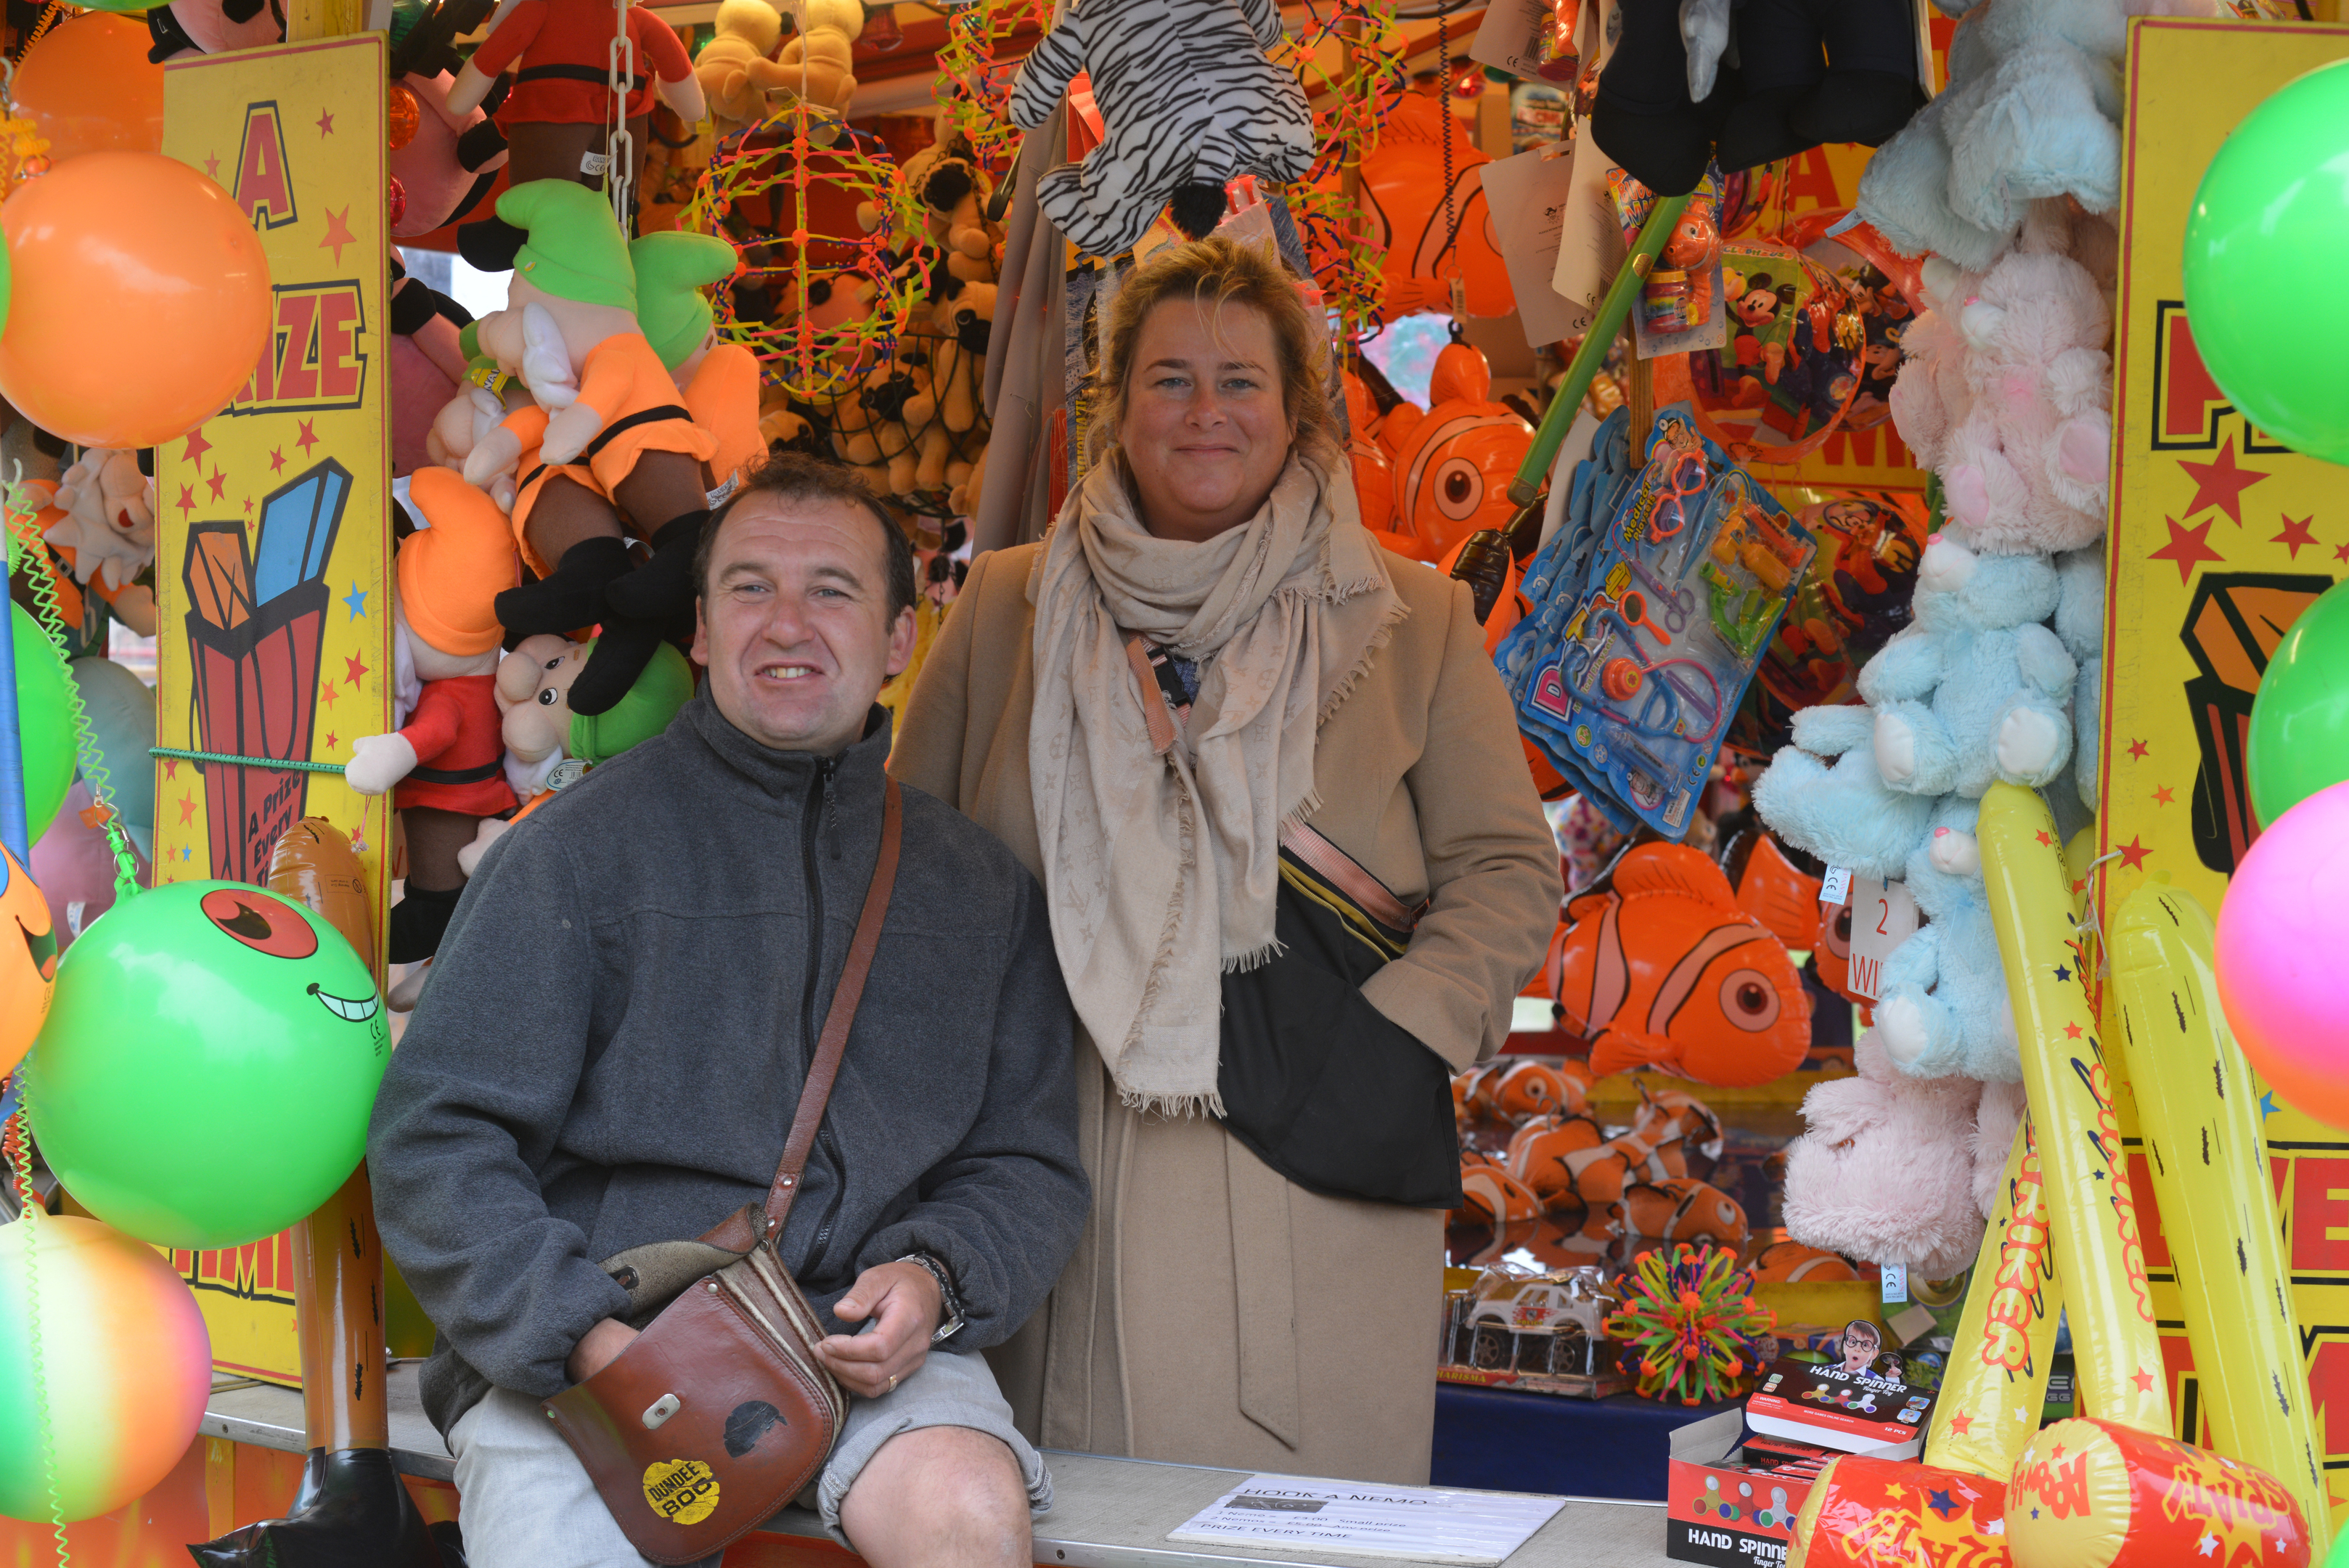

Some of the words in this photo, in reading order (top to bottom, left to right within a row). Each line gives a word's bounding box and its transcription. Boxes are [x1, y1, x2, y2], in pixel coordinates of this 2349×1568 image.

[1624, 481, 1651, 543] Medical
[1633, 494, 1656, 542] Playsets
[248, 810, 259, 844] A
[264, 771, 301, 825] Prize
[253, 804, 293, 869] Every
[1876, 899, 1888, 935] 2
[1852, 953, 1882, 997] WI
[1437, 1371, 1487, 1384] HARISMA
[1810, 1365, 1850, 1381] HAND
[1853, 1376, 1908, 1393] SPINNER
[647, 1462, 700, 1503] DUNDEE
[1243, 1489, 1318, 1498] HOOK
[1349, 1495, 1428, 1504] NEMO
[1688, 1528, 1733, 1550] HAND
[1739, 1538, 1787, 1561] SPINNE
